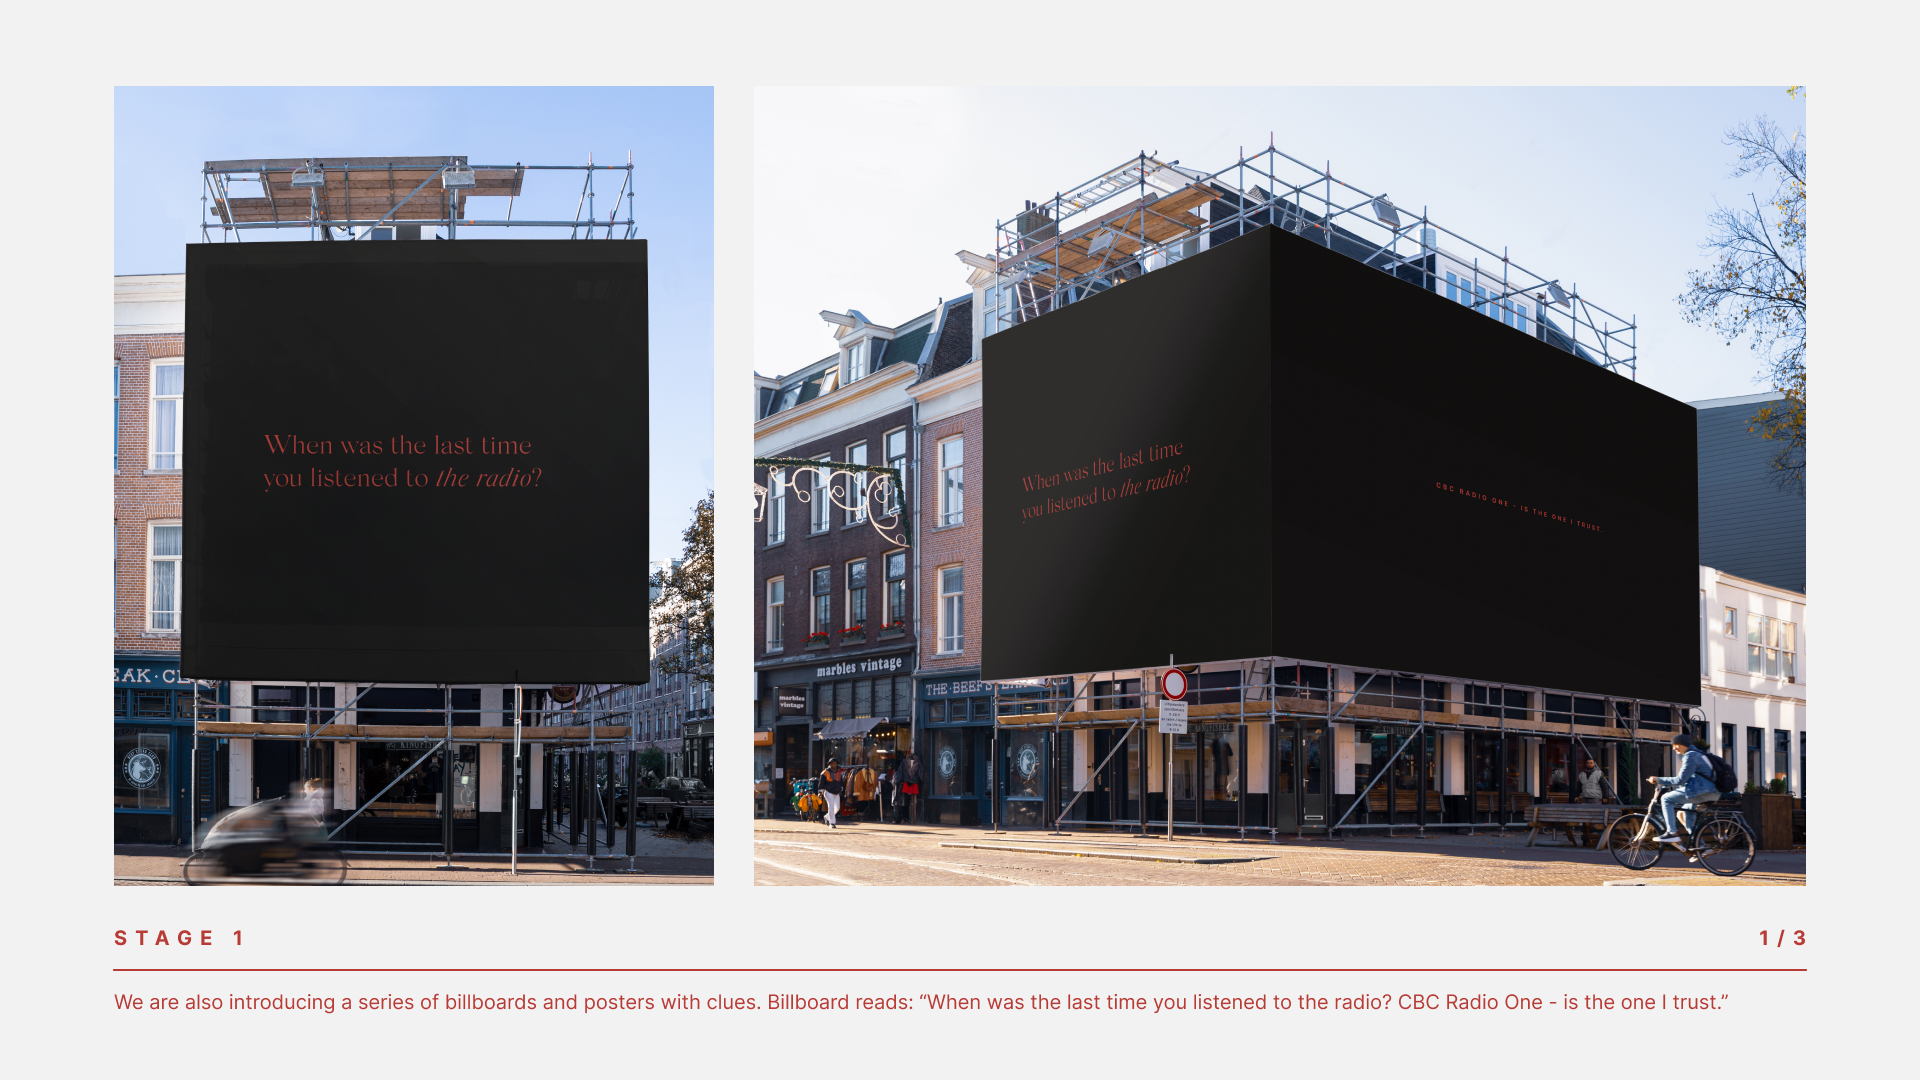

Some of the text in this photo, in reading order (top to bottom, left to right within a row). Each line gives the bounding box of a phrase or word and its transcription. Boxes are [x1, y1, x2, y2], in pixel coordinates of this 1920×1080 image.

[265, 434, 532, 455] When was the last time
[263, 467, 542, 492] you listened to the radio?
[1022, 442, 1183, 492] When was the last time
[1022, 464, 1191, 524] you listened to the radio?
[1436, 482, 1455, 492] CBC
[1459, 488, 1487, 501] RADIO
[1492, 498, 1508, 507] ONE
[1520, 505, 1529, 513] IS
[1533, 508, 1548, 518] THE
[1552, 514, 1567, 523] ONE
[1577, 520, 1603, 533] TRUST.
[816, 657, 902, 678] marbles vintage
[926, 683, 948, 696] THE
